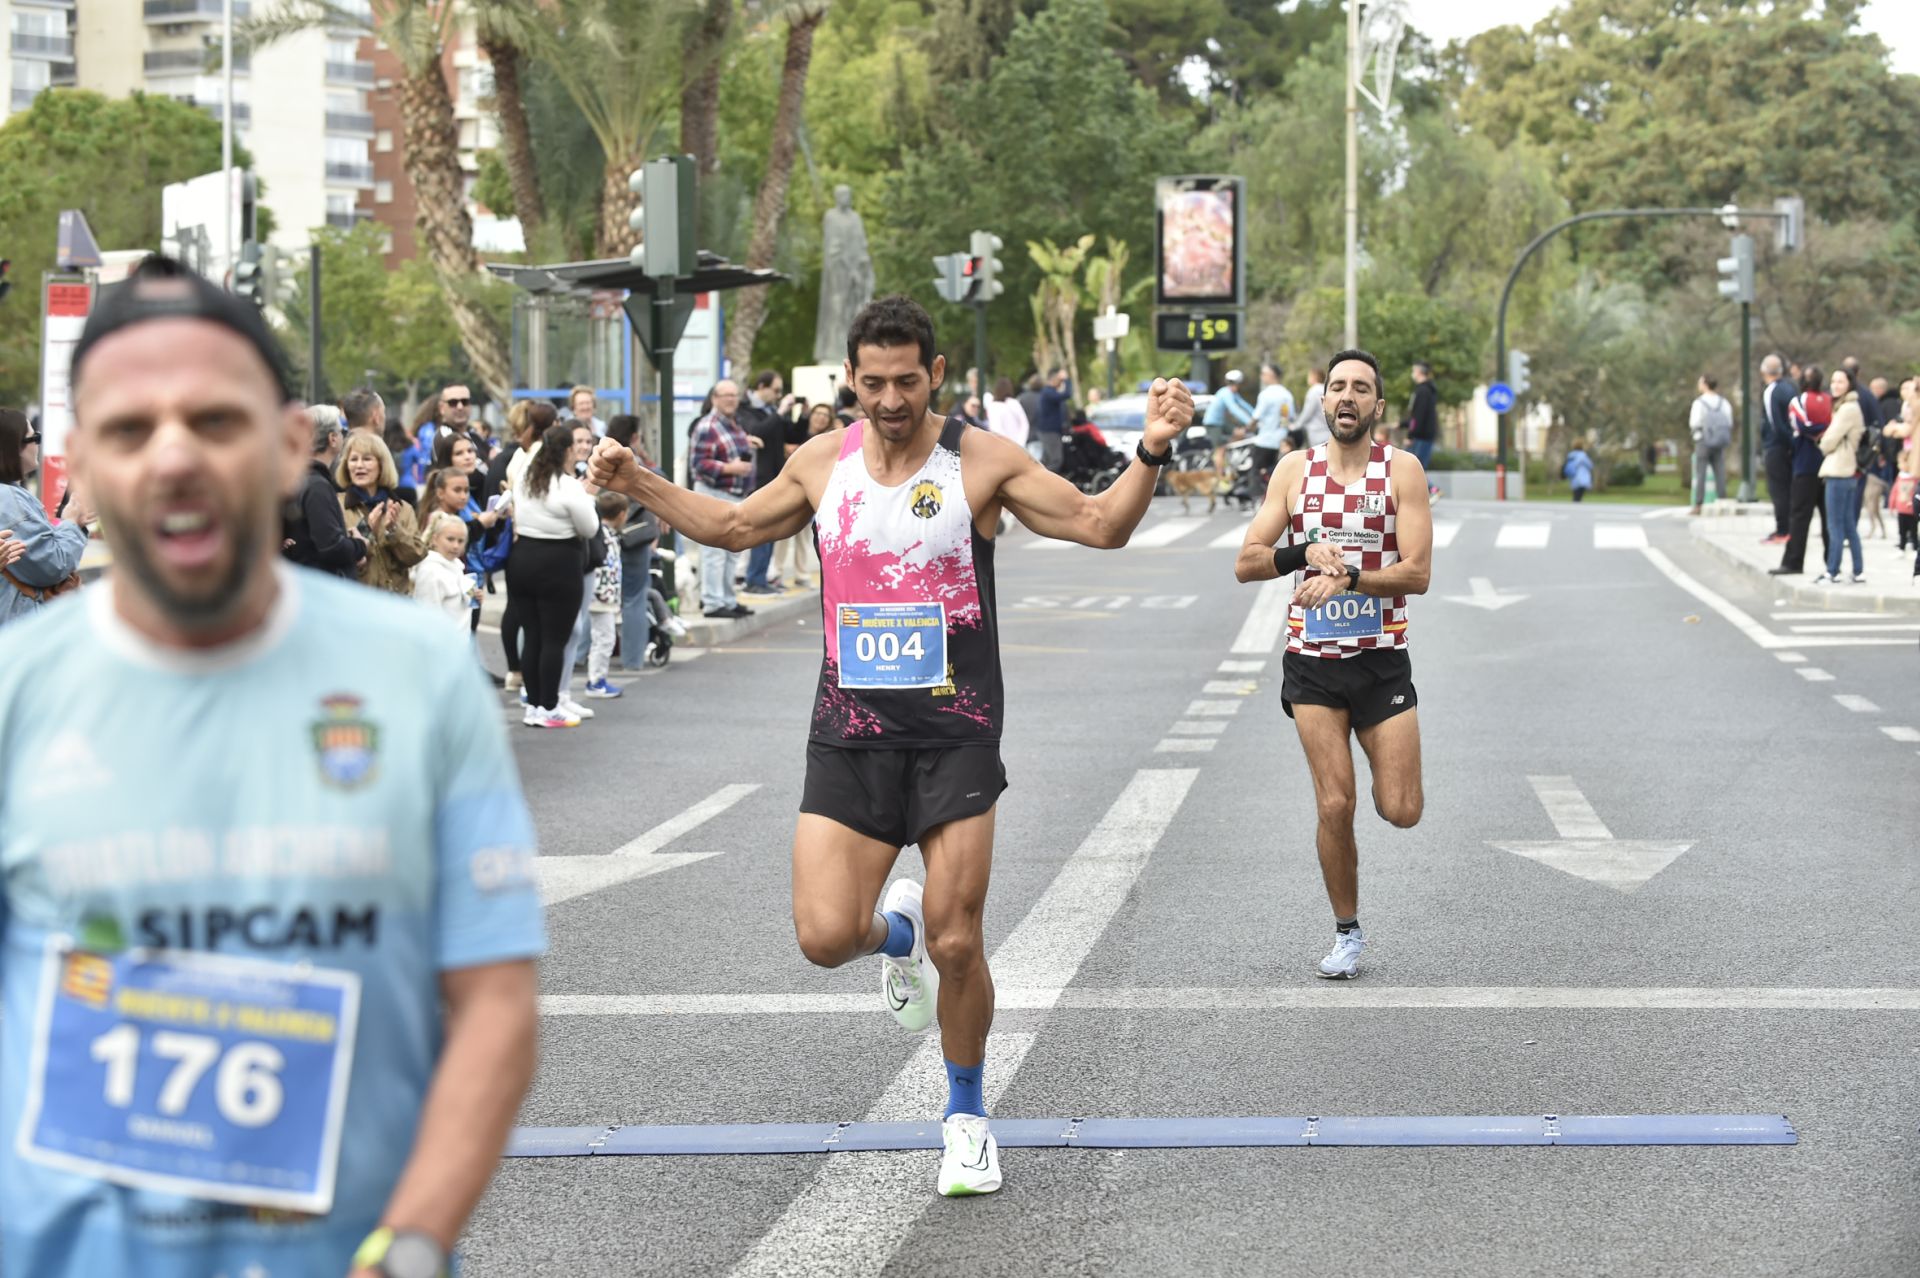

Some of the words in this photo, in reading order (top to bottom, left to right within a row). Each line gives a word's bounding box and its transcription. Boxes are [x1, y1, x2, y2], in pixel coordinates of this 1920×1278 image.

[1328, 530, 1353, 538] Centro
[1353, 530, 1380, 539] Médico
[1311, 597, 1377, 621] 1004
[896, 618, 903, 627] X
[904, 617, 940, 628] VALENCIA
[855, 631, 925, 661] 004
[875, 664, 901, 672] HENRY
[136, 902, 381, 950] SIPCAM
[90, 1022, 287, 1128] 176
